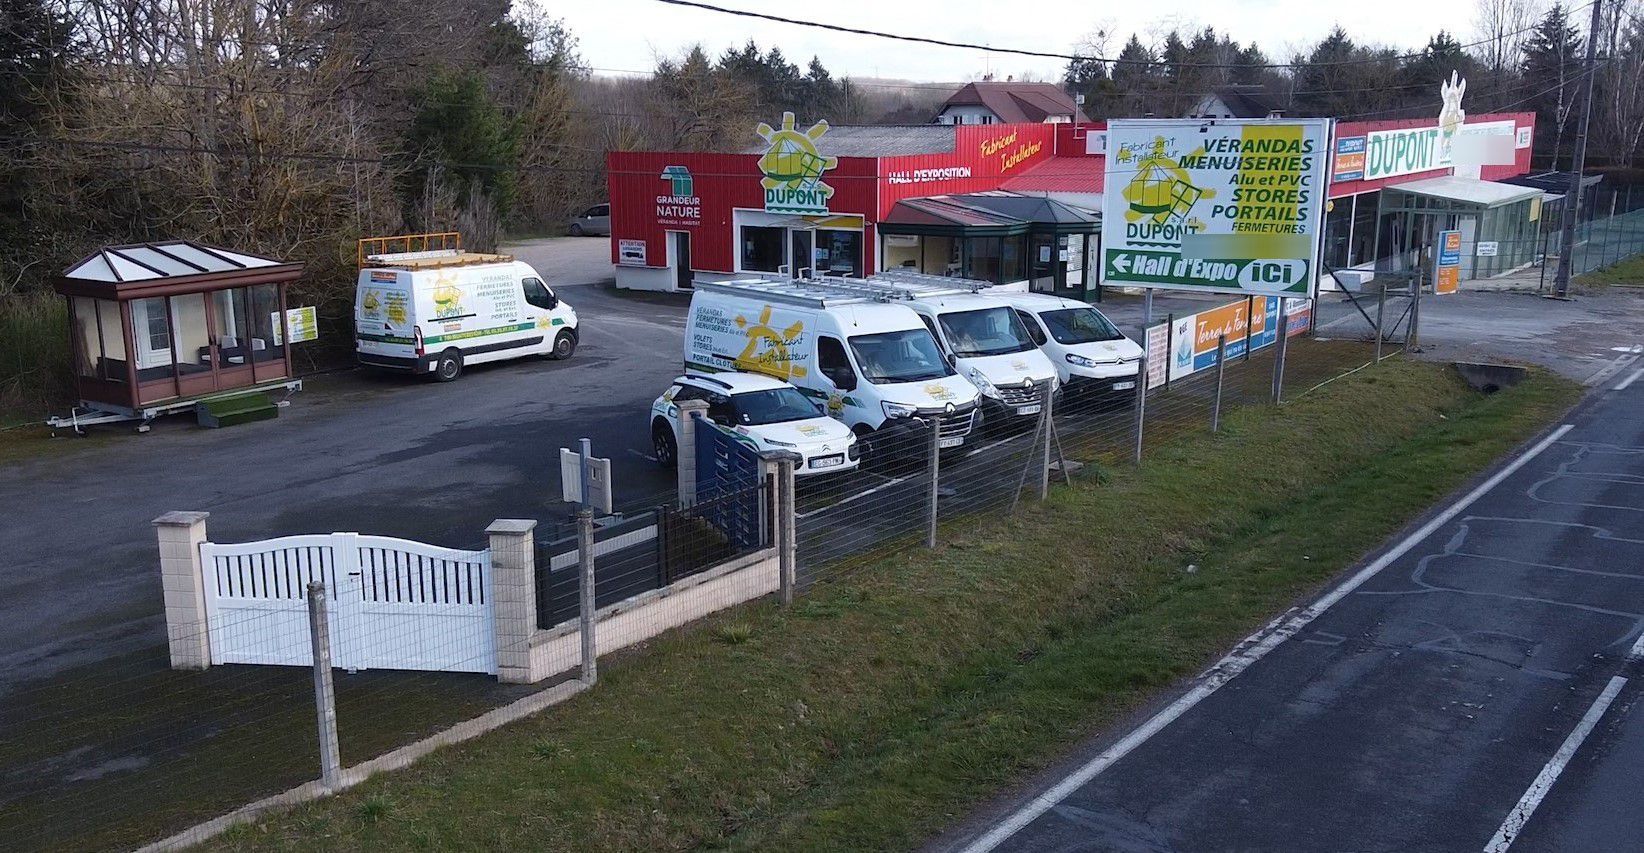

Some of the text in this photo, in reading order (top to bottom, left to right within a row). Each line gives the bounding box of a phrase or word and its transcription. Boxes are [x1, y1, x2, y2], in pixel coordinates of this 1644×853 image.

[980, 126, 1017, 158] Fabricant
[1120, 136, 1176, 153] Fabricant
[1203, 136, 1314, 153] VÉRANDAS
[1000, 140, 1042, 174] Installateur
[1115, 150, 1180, 165] Installateur
[1369, 130, 1438, 176] DUPONT
[1178, 155, 1312, 171] MENUISERIES
[888, 167, 971, 184] HALL D'EXPOSITION
[1228, 173, 1312, 186] Alu et PVC
[656, 196, 700, 205] GRANDEUR
[766, 189, 827, 206] DUPONT
[1231, 188, 1310, 204] STORES
[656, 205, 701, 218] NATURE
[1211, 205, 1308, 221] PORTAILS
[1126, 223, 1199, 240] DUPONT
[1231, 221, 1306, 234] FERMETURES
[1132, 254, 1172, 276] Hall
[1173, 258, 1238, 281] d'Expo
[491, 311, 518, 320] PORTAILS
[695, 314, 732, 327] FERMETURES
[695, 321, 729, 334] MENUISERIES
[693, 333, 713, 344] VOLETS
[693, 341, 713, 352] STORES
[763, 331, 804, 348] Fabricant
[692, 353, 715, 365] PORTAIL
[757, 347, 809, 365] Installateur
